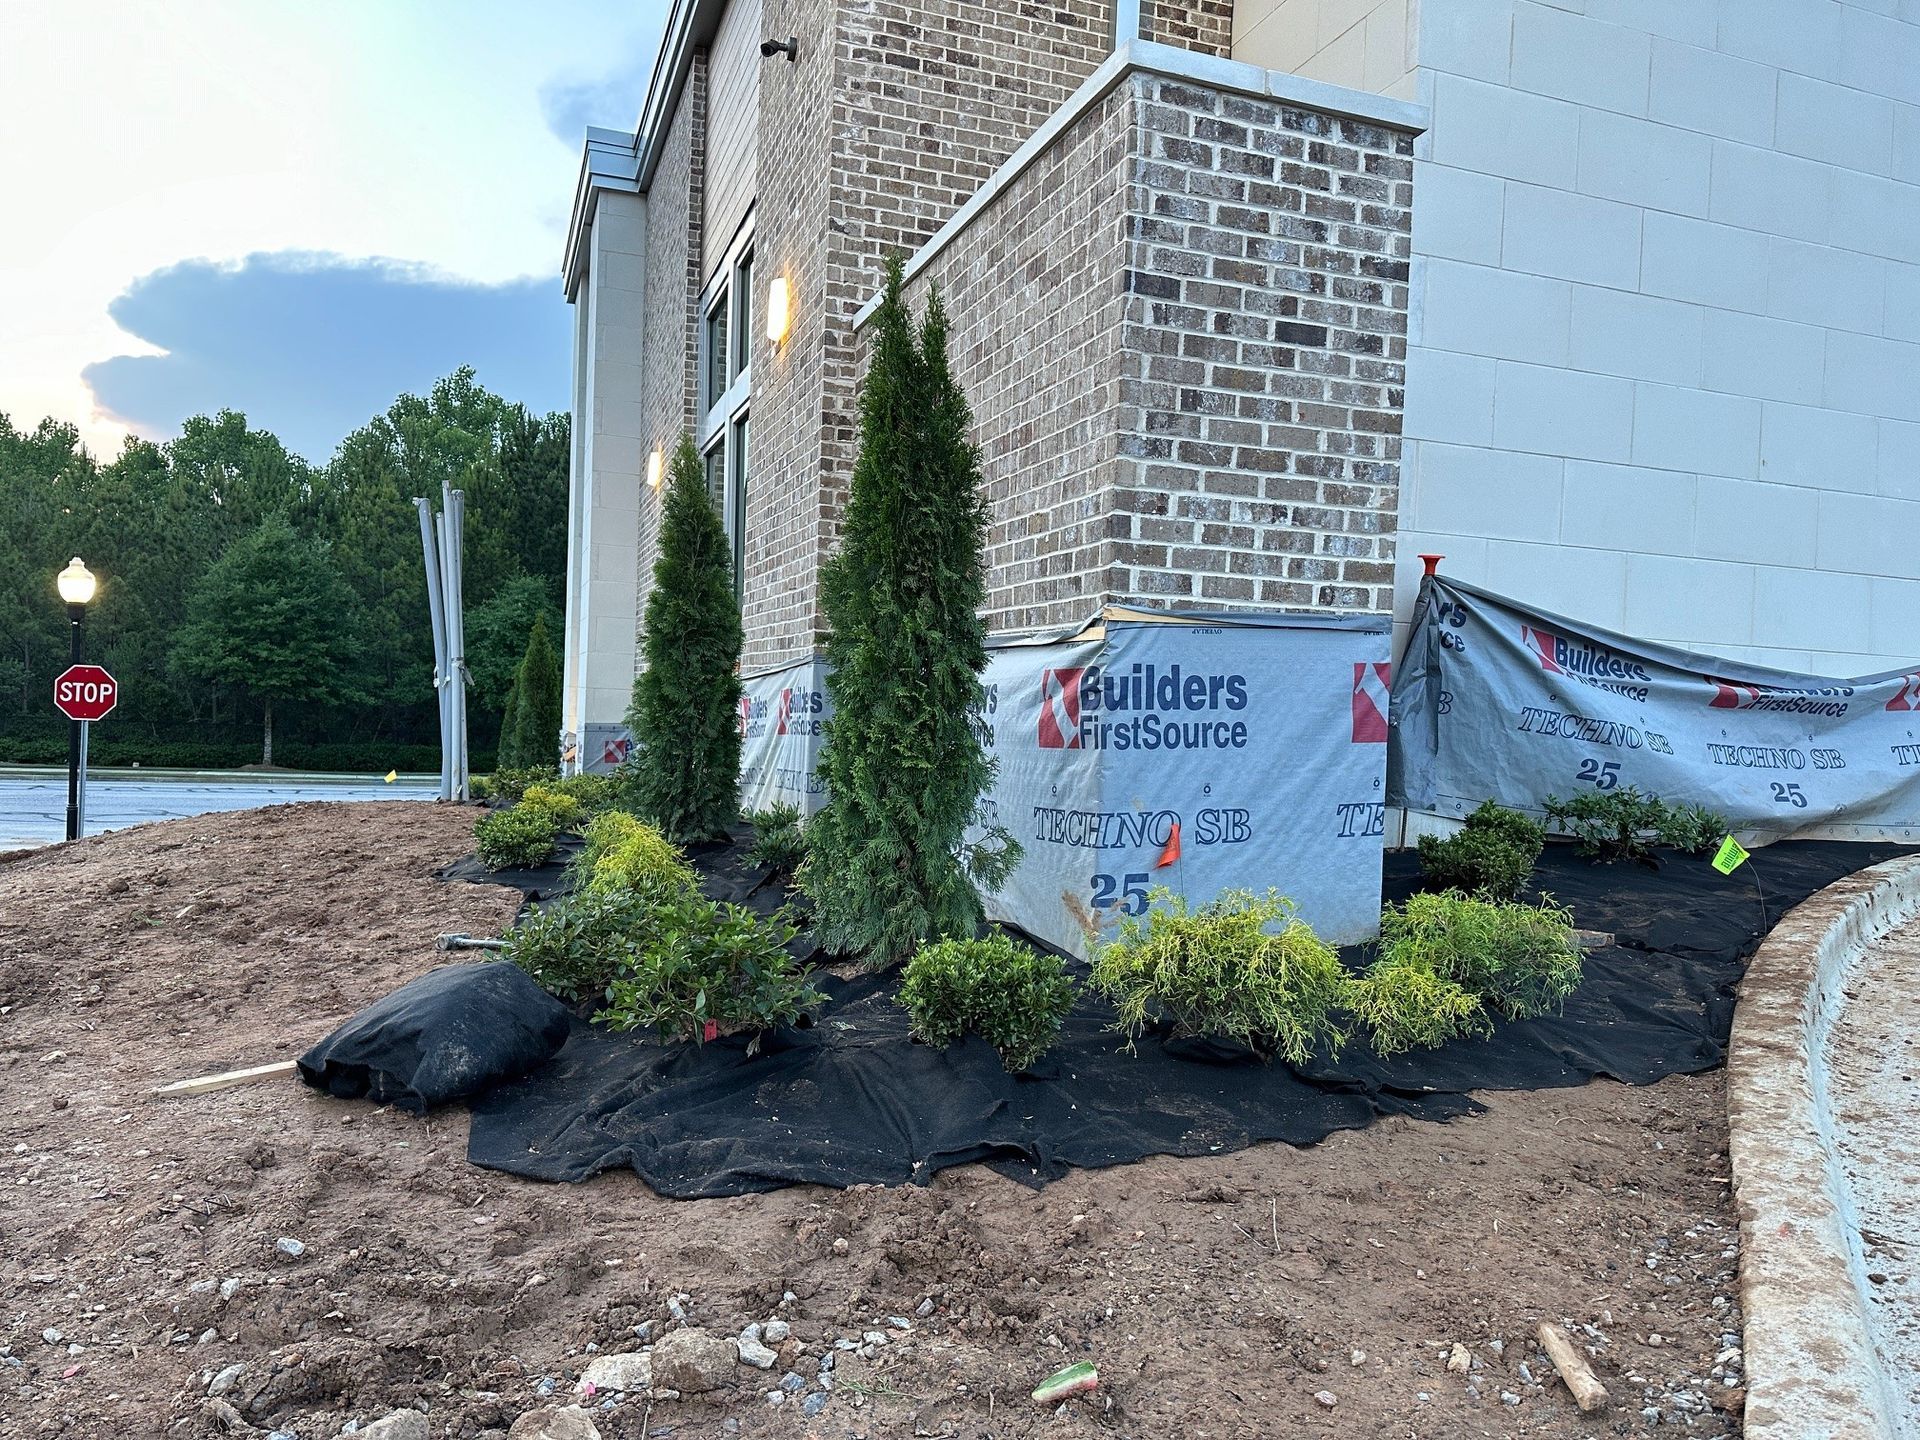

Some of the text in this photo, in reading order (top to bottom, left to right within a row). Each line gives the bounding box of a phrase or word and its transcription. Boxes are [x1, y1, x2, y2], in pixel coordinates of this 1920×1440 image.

[1555, 636, 1652, 682] Builders
[59, 681, 113, 703] STOP
[1080, 663, 1248, 712] Builders
[1750, 694, 1849, 717] FirstSource
[1080, 714, 1248, 750] FirstSource
[1517, 706, 1675, 755] TECHNO SB
[1575, 758, 1622, 790] 25
[1706, 743, 1847, 770] TECHNO SB
[1769, 782, 1808, 808] 25
[1033, 806, 1253, 849] TECHNO SB
[1090, 872, 1150, 917] 25
